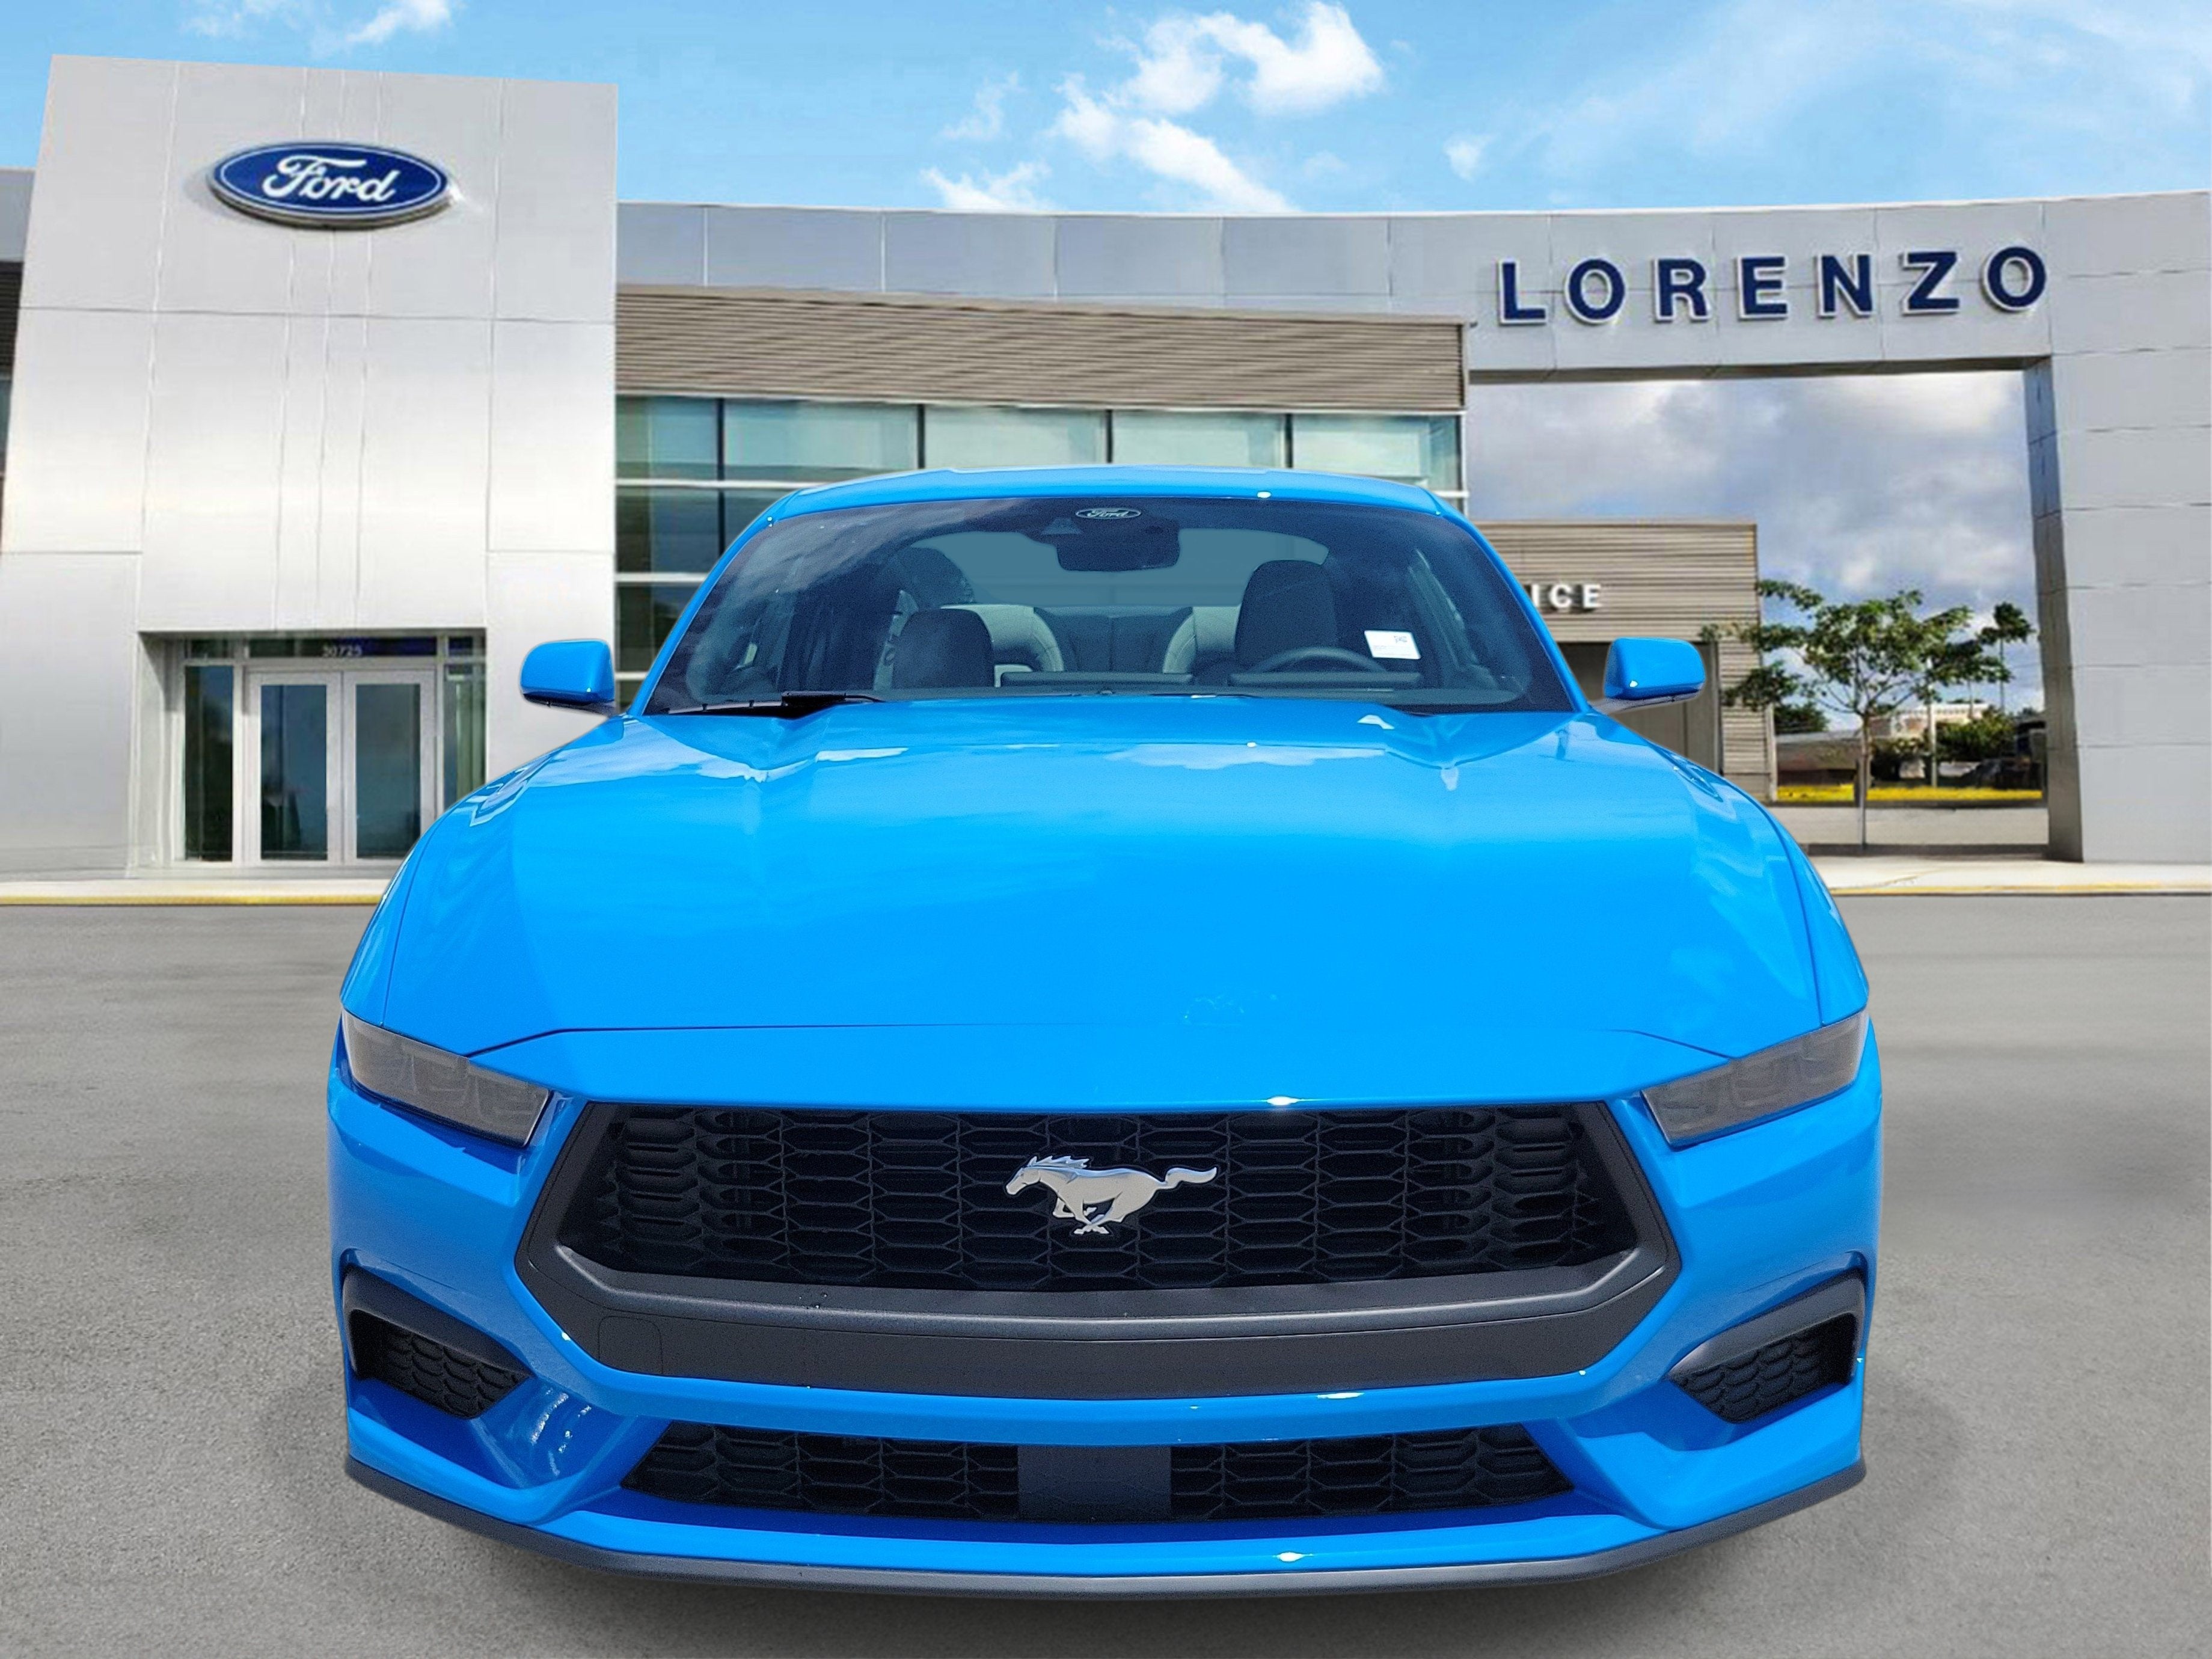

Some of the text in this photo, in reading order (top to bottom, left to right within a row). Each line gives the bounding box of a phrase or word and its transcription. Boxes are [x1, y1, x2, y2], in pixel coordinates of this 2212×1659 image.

[262, 154, 400, 201] Ford
[1497, 247, 2047, 325] LORENZO
[1086, 508, 1129, 518] Ford
